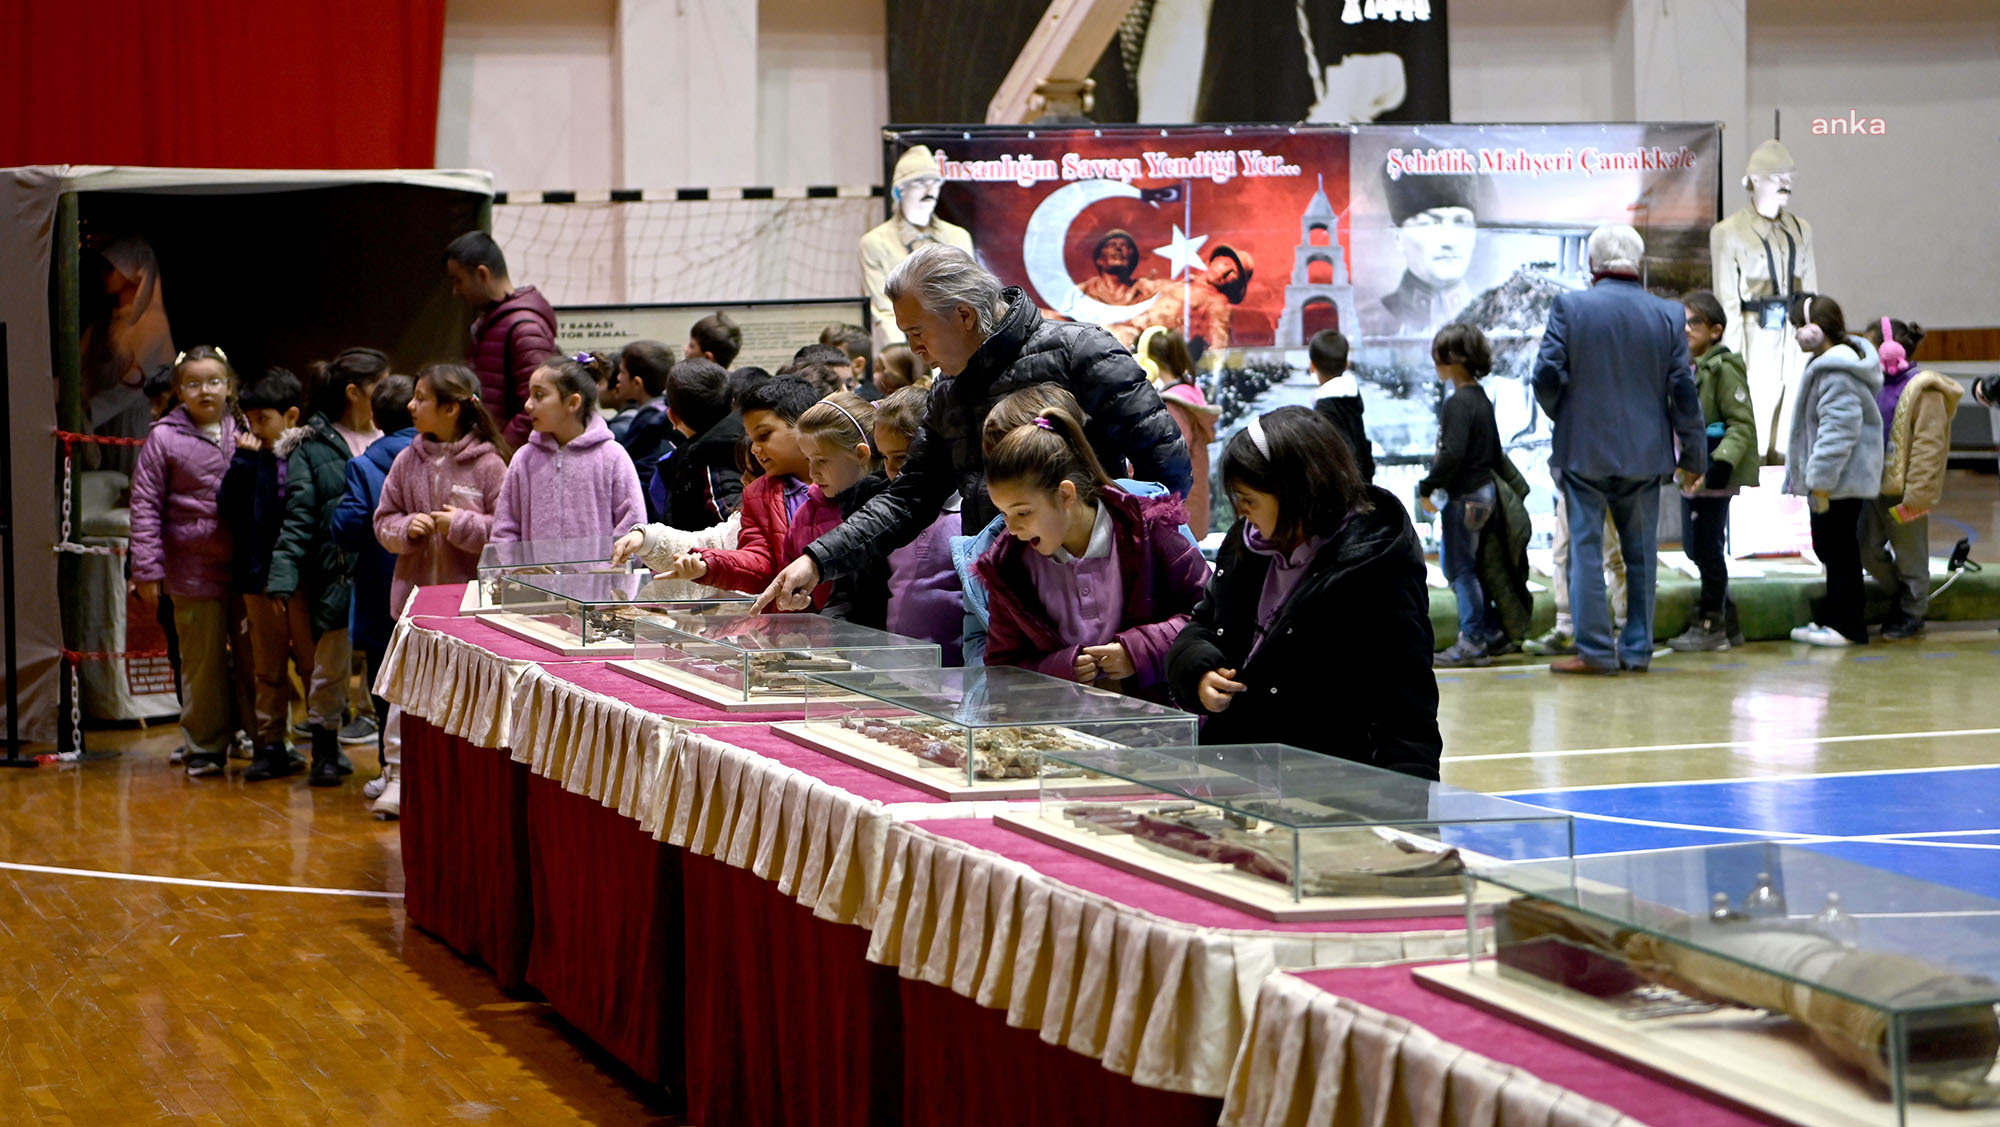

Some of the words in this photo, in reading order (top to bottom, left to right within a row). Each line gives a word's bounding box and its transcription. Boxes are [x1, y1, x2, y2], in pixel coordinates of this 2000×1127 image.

[934, 149, 1059, 187] İnsanlığın
[1061, 152, 1143, 184] Savaşı
[1142, 151, 1238, 183] Yendiği
[1387, 148, 1476, 181] Şehitlik
[1478, 147, 1575, 178] Mahşeri
[1578, 146, 1698, 178] Çanakkale
